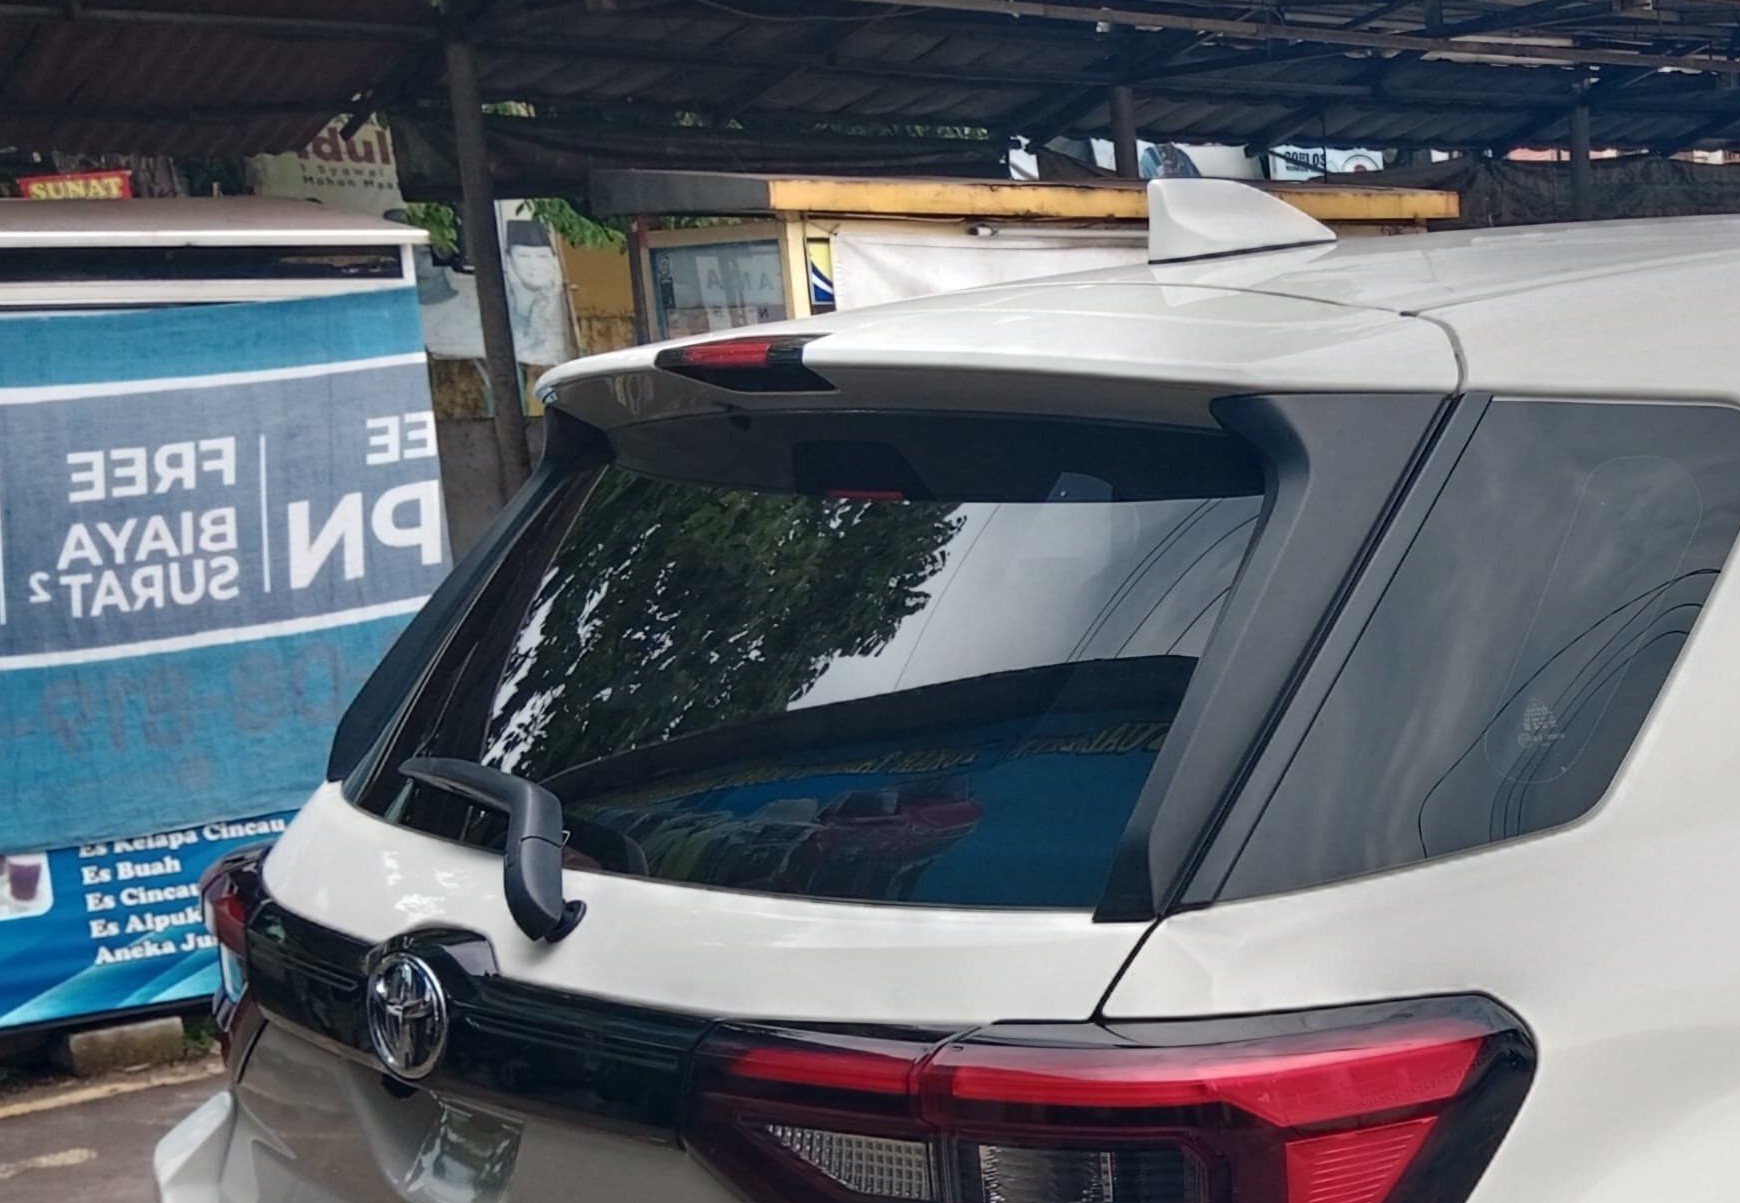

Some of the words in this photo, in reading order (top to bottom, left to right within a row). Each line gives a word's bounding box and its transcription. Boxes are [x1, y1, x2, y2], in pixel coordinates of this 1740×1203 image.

[300, 127, 391, 165] dul
[29, 177, 123, 199] SUNAT
[202, 817, 286, 841] Cincau
[81, 866, 112, 885] Es
[116, 856, 182, 881] Buah
[85, 893, 116, 912] Es
[90, 920, 120, 939] Es
[95, 941, 177, 966] Aneka
